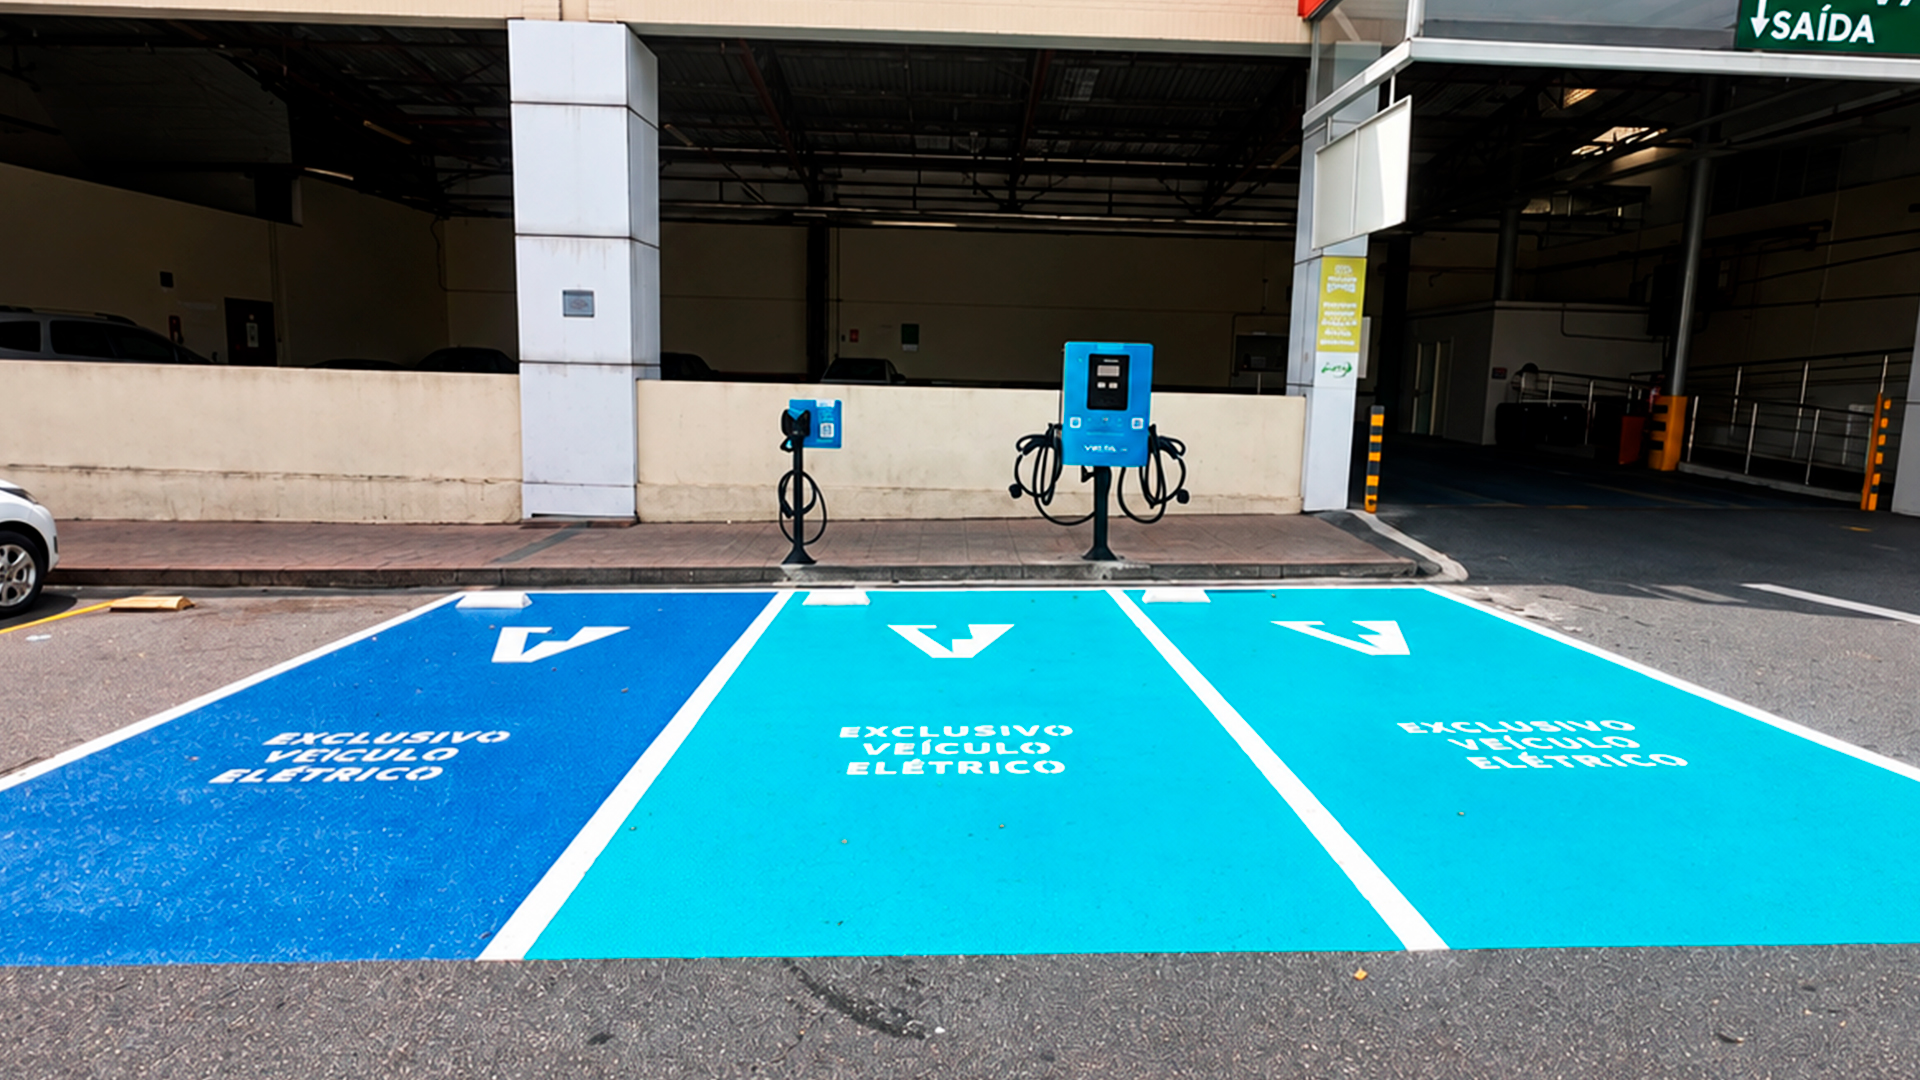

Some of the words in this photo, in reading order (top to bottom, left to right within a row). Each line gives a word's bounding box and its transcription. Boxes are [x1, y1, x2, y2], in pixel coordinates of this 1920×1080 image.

[1771, 4, 1875, 44] SAÍDA
[840, 724, 1074, 738] EXCLUSIVO
[1397, 719, 1636, 734] EXCLUSIVO
[262, 730, 511, 746] EXCLUSIVO
[1447, 734, 1641, 751] VEÍCULO
[863, 739, 1051, 756] VEÍCULO
[846, 758, 1066, 776] ELÉTRICO
[1466, 751, 1688, 770] ELÉTRICO
[208, 765, 444, 784] ELÉTRICO
